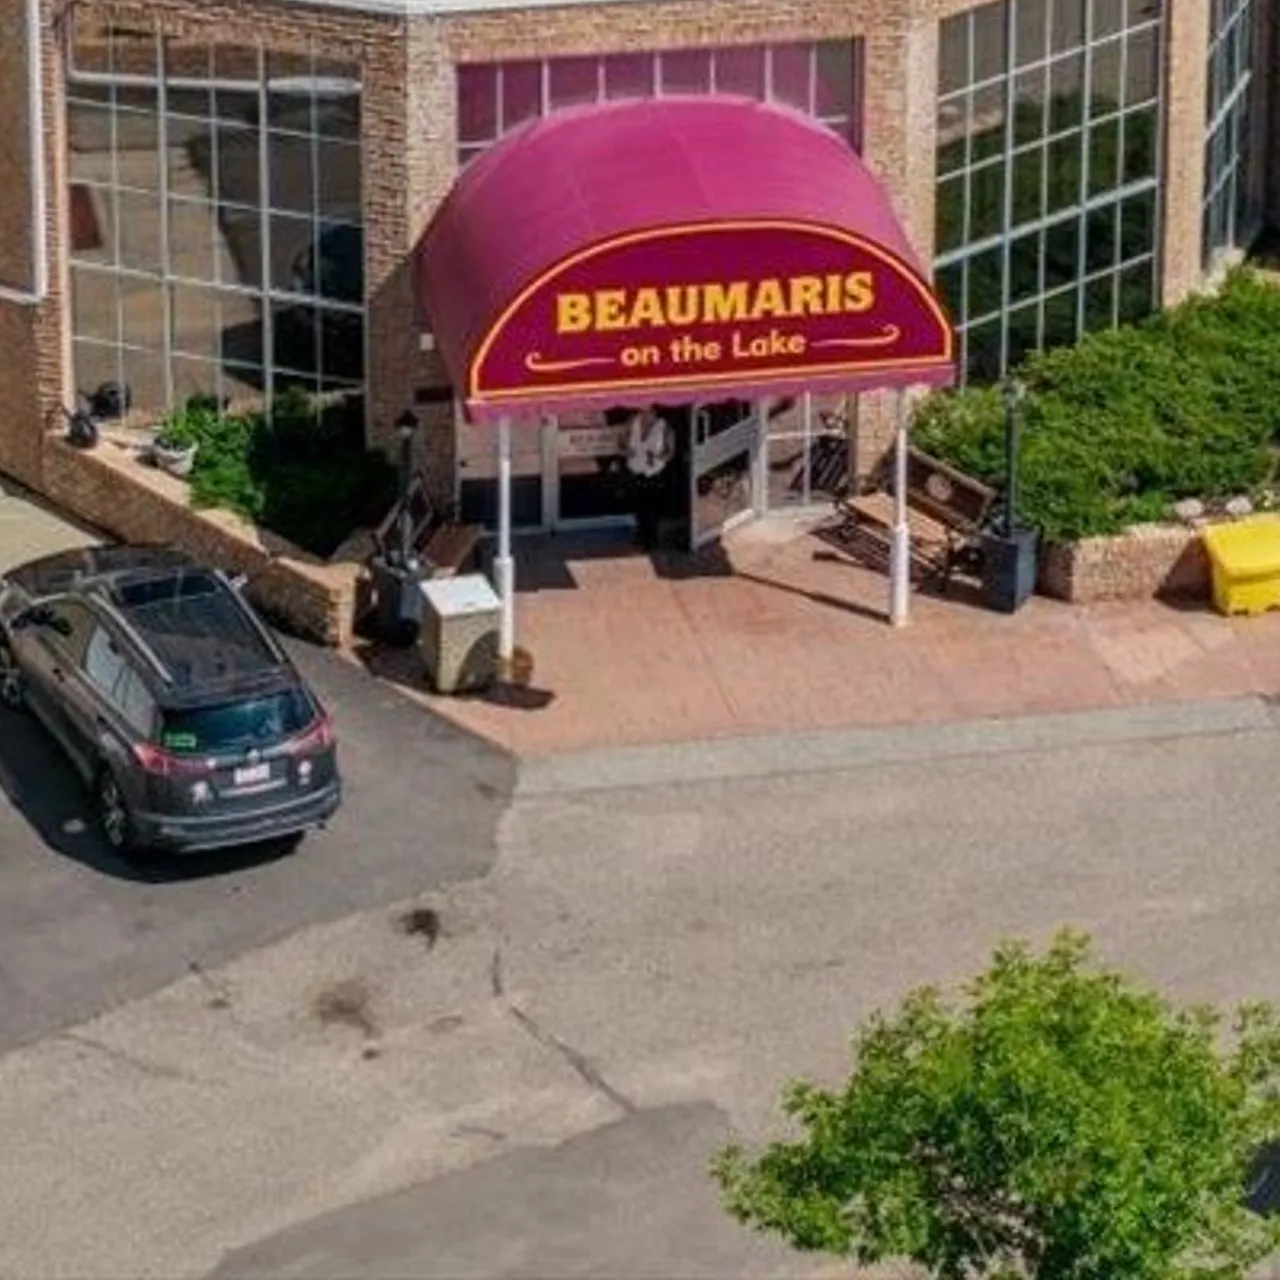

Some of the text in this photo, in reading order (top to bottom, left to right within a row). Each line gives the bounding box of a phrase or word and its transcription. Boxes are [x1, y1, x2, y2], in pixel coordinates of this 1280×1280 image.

[556, 271, 875, 334] BEAUMARIS
[621, 329, 807, 366] on the Lake
